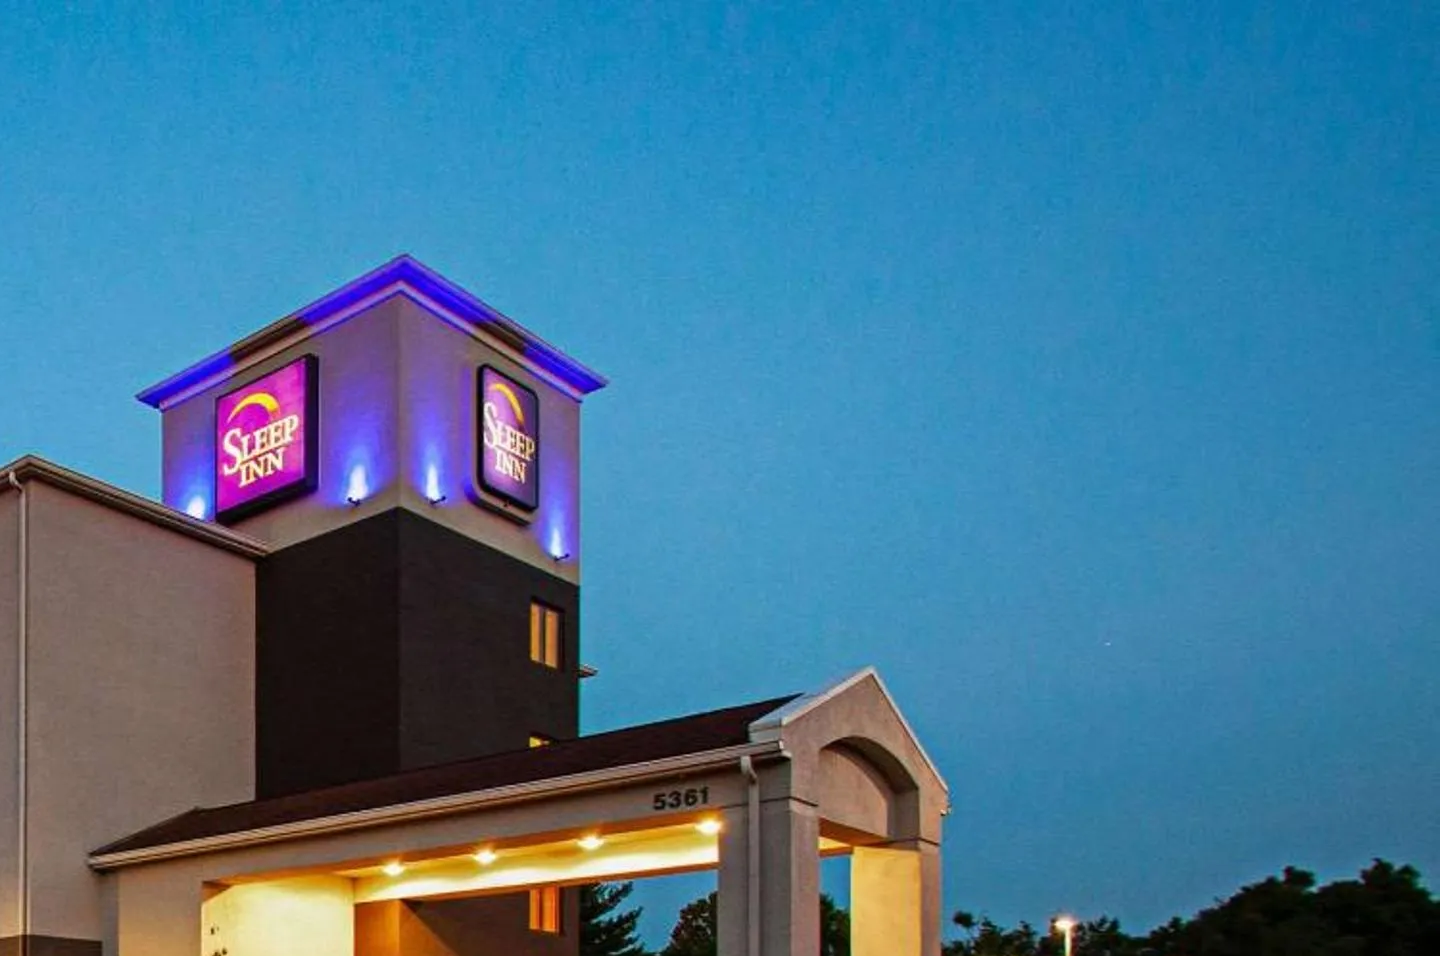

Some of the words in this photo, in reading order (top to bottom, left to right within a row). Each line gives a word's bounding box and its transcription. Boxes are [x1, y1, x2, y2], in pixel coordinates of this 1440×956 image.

[224, 414, 299, 476] SLEEP
[484, 401, 535, 461] SLEEP
[239, 447, 284, 488] INN
[495, 449, 526, 484] INN
[653, 786, 709, 811] 5361
